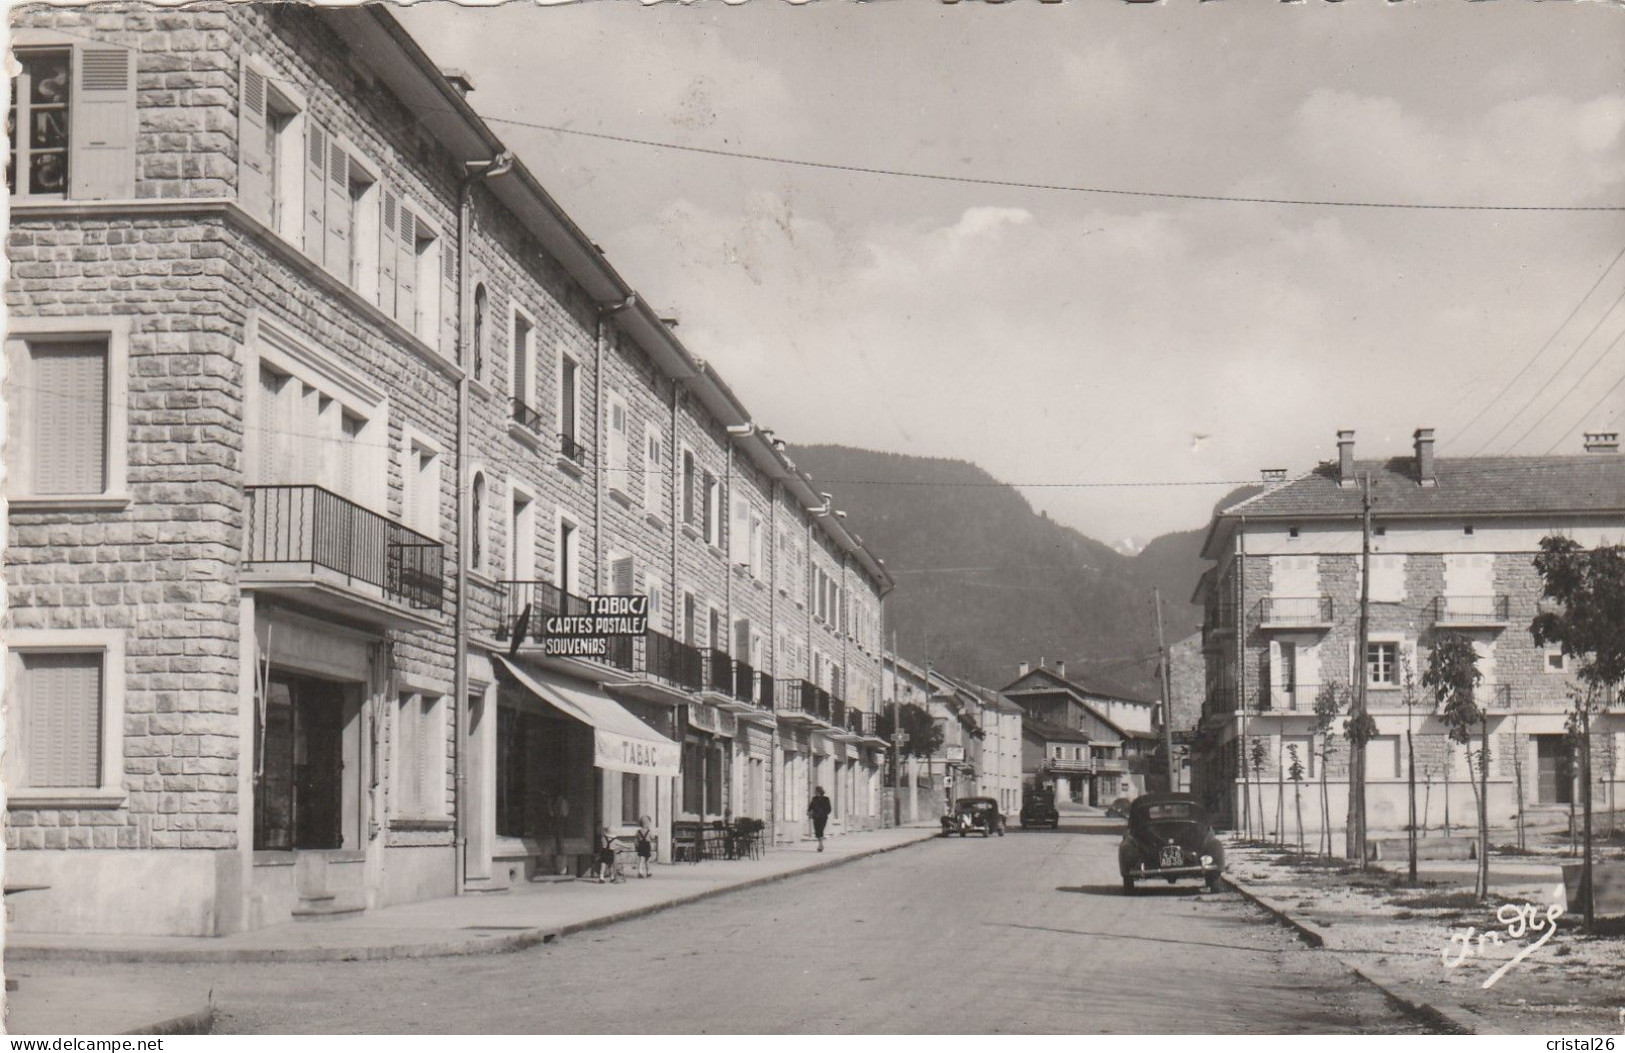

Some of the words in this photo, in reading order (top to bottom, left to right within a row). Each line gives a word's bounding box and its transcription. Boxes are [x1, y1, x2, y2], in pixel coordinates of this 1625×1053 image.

[588, 597, 647, 614] TABACS
[547, 617, 593, 634] CARTES
[595, 617, 647, 634] POSTALES
[622, 740, 657, 768] TABAC
